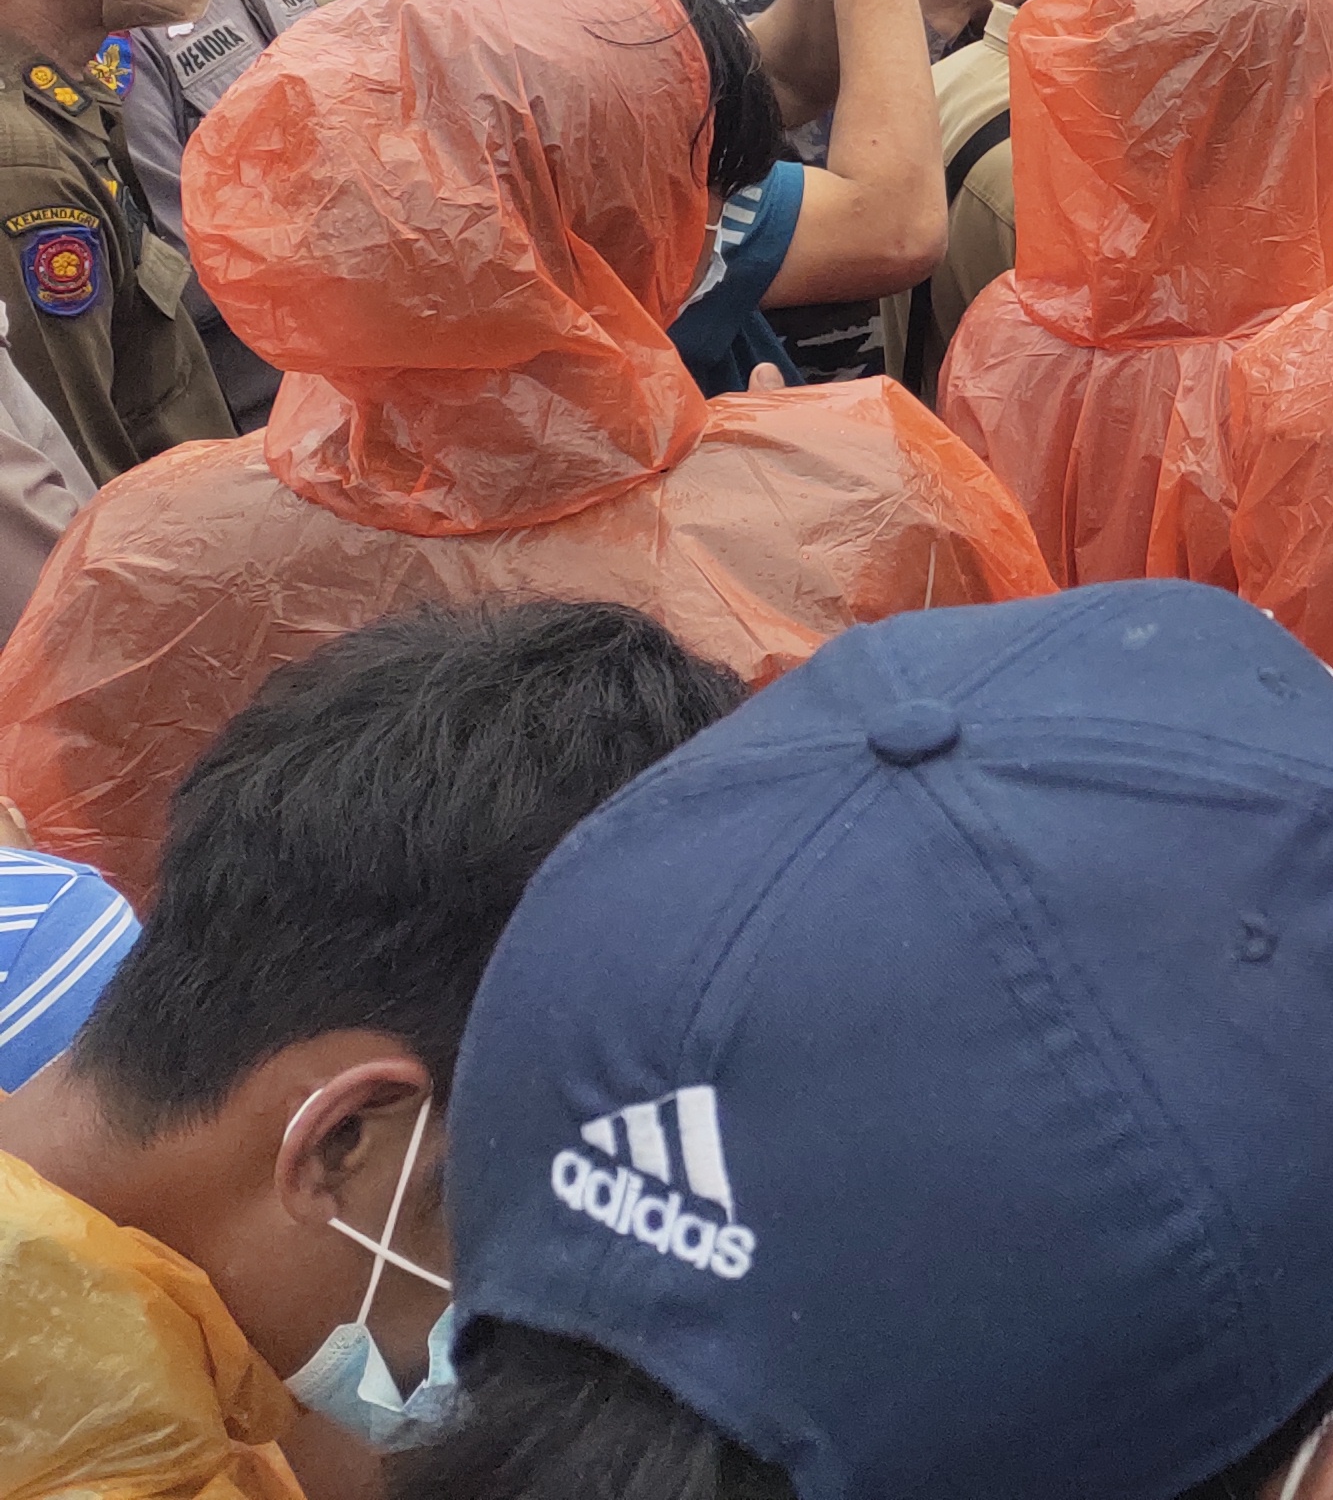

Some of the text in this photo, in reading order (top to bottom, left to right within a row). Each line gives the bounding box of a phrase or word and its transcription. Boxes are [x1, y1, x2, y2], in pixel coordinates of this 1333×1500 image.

[176, 25, 245, 78] HENDRA
[11, 208, 98, 230] KEMENDAGRI
[552, 1149, 757, 1280] adidas
